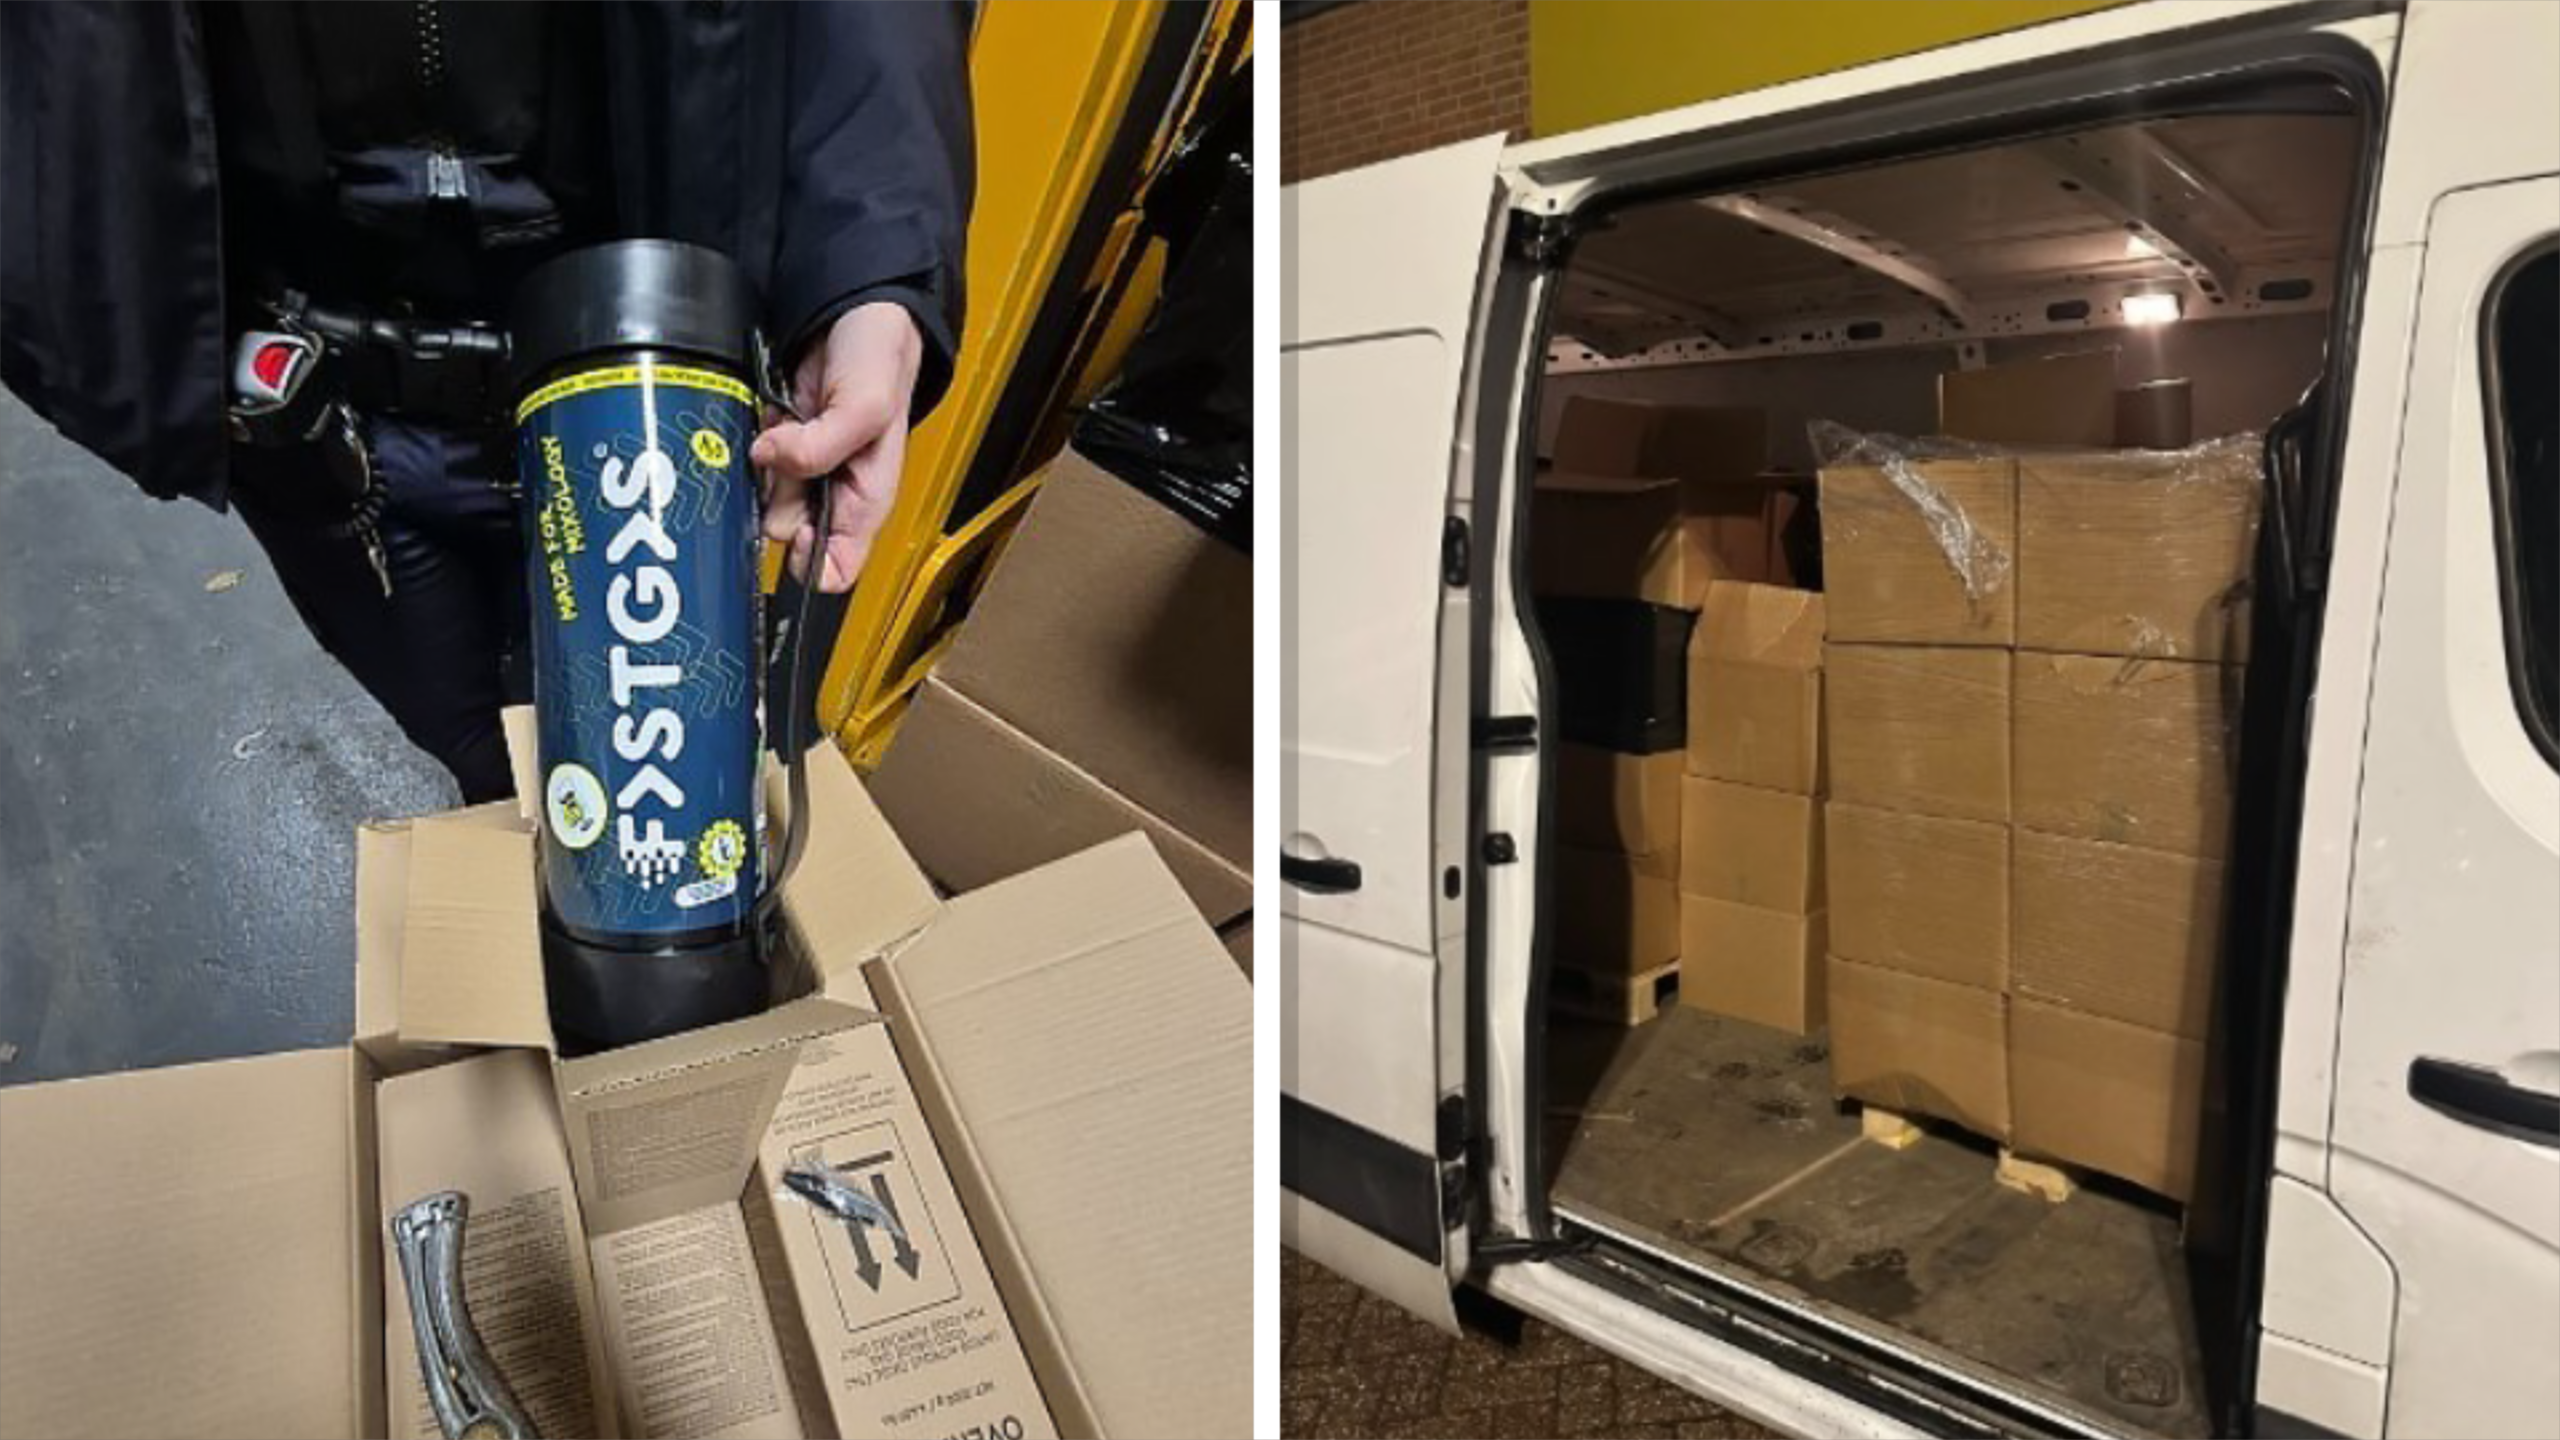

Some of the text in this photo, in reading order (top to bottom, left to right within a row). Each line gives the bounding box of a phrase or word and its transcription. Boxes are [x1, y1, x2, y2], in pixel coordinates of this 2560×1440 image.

[540, 435, 587, 554] MIXOLOGY
[539, 502, 578, 621] MADE FOR
